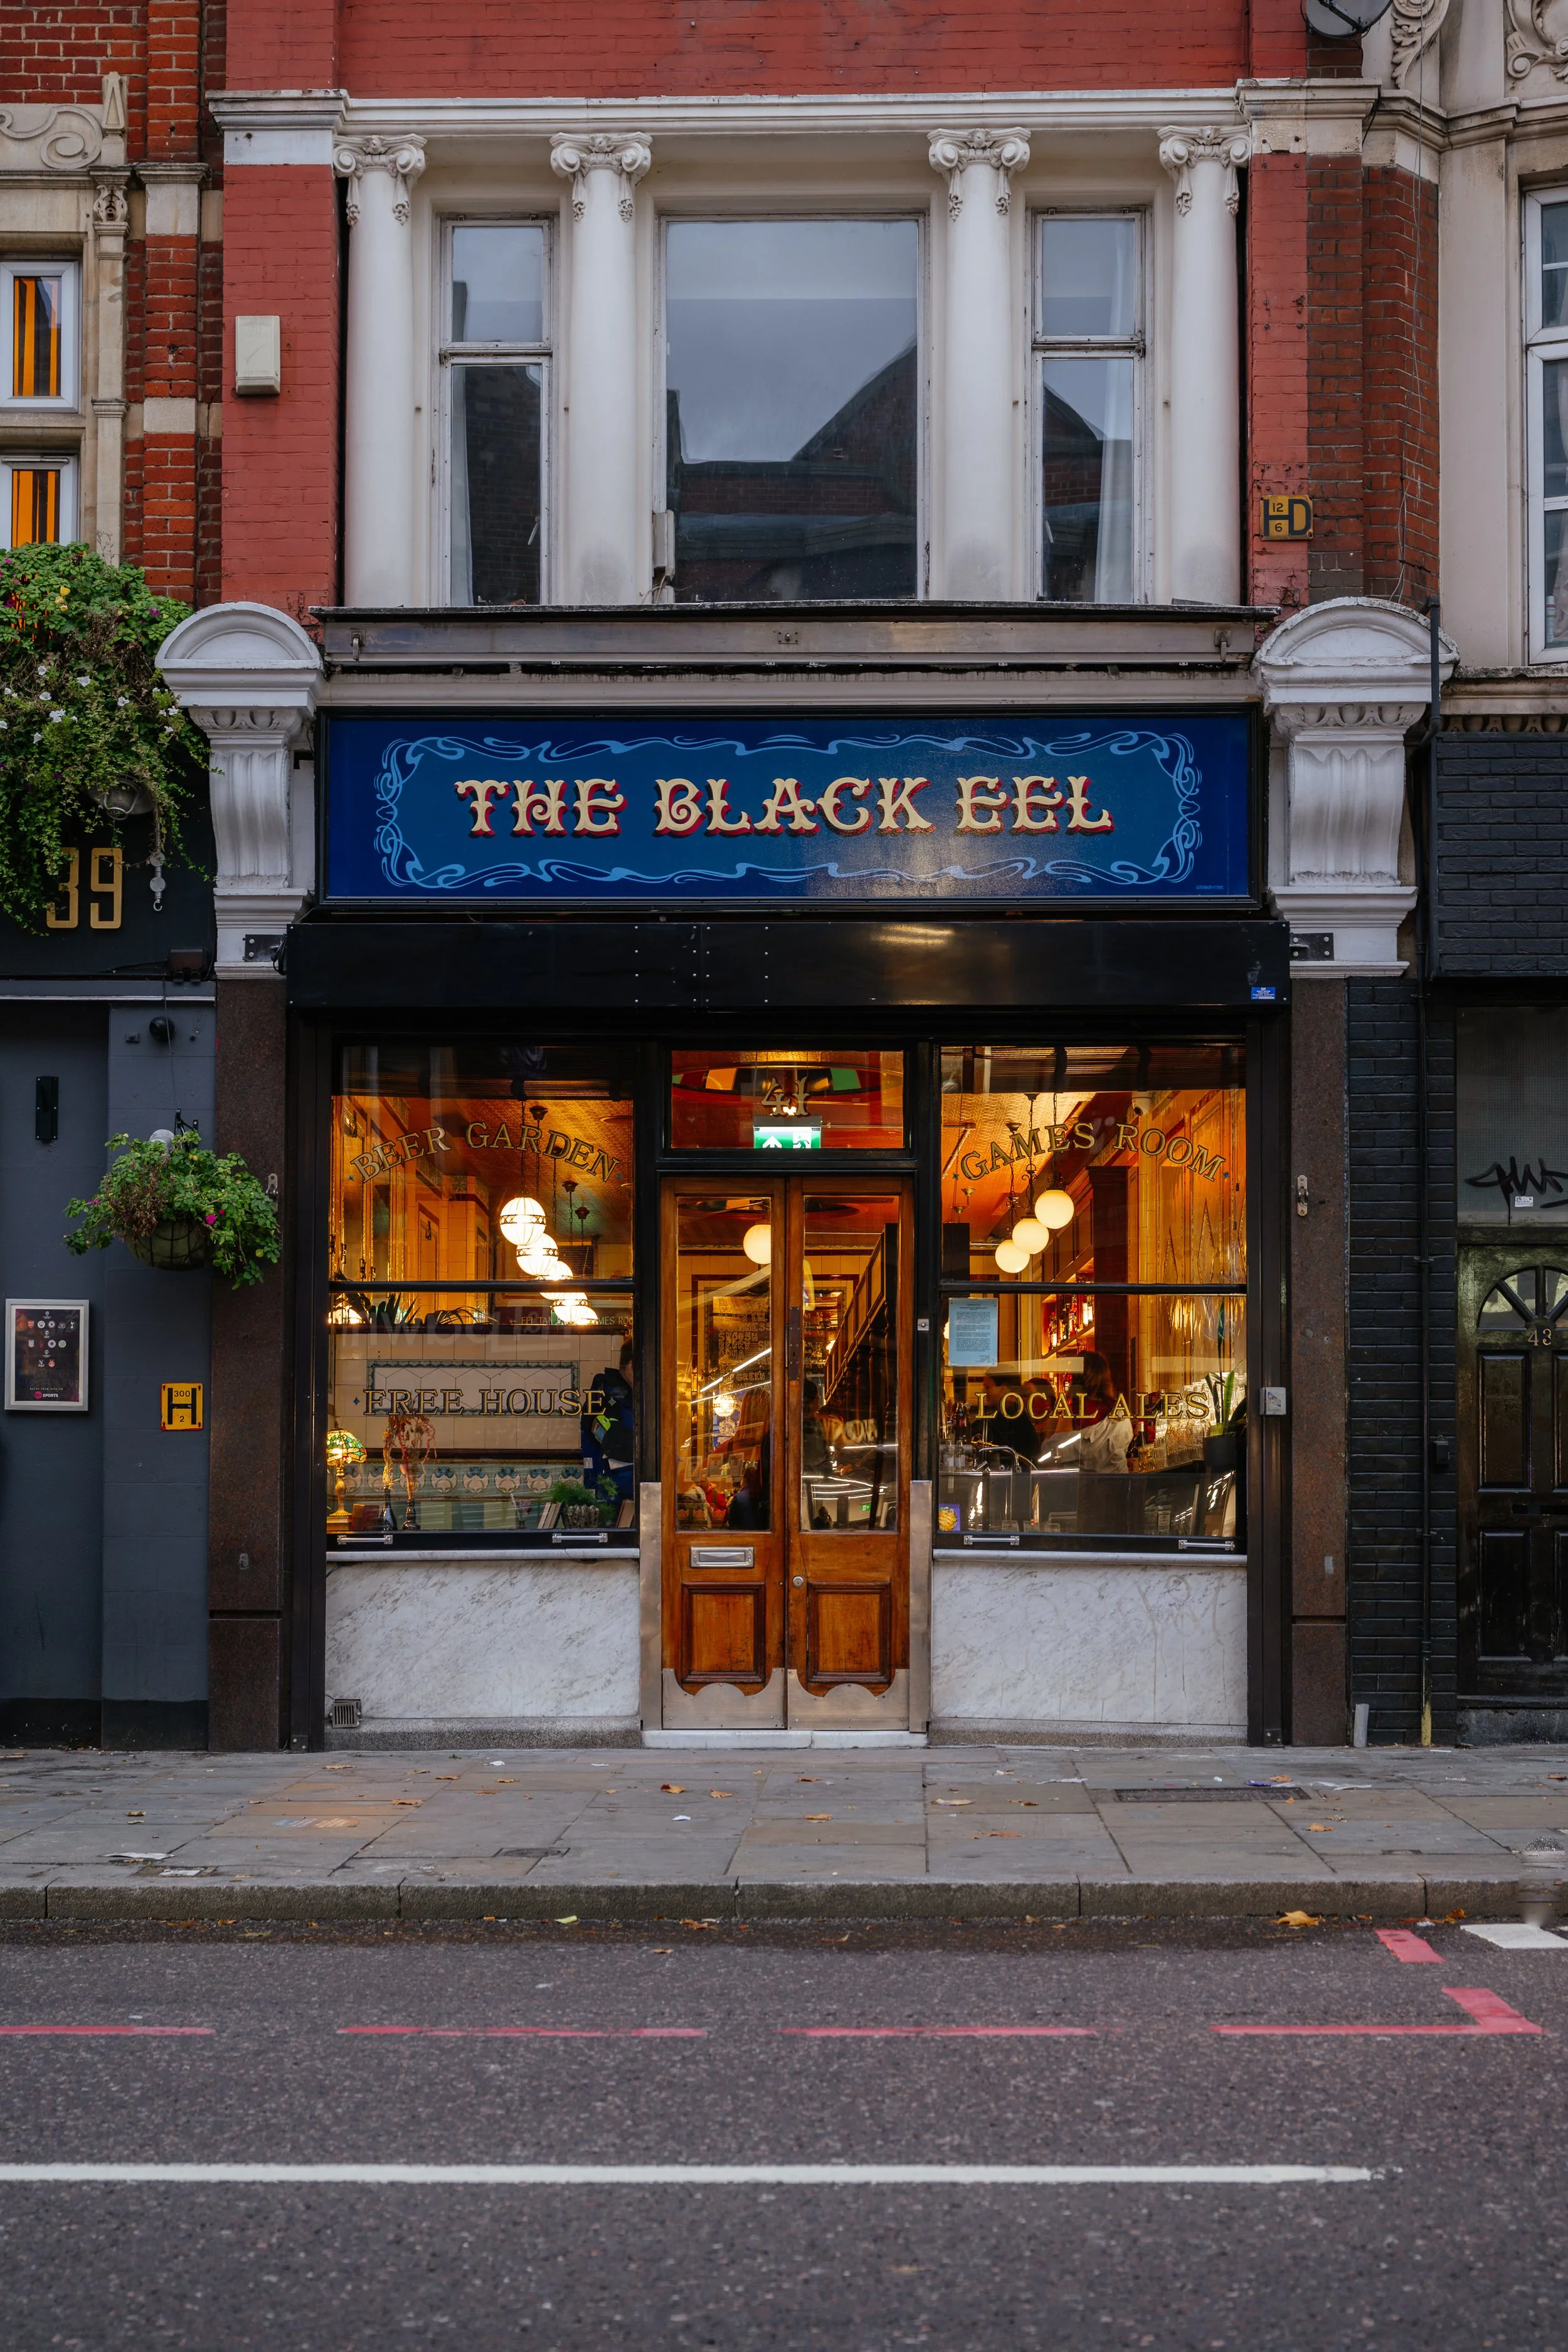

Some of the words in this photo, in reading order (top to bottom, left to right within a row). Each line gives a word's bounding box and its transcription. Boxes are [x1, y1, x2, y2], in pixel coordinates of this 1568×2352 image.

[1272, 502, 1284, 512] 12
[1274, 522, 1283, 532] 6
[455, 778, 627, 838] THE
[654, 777, 935, 838] BLACK
[955, 775, 1115, 836] EEL
[46, 847, 123, 929] 39
[760, 1076, 811, 1117] 41
[349, 1125, 452, 1184] BEER
[465, 1121, 622, 1183] GARDEN
[960, 1122, 1097, 1182] GAMES
[1113, 1123, 1227, 1183] ROOM
[718, 1341, 750, 1350] BERRY
[1527, 1326, 1552, 1347] 43
[736, 1372, 765, 1381] GREEN
[167, 1387, 197, 1425] H
[362, 1388, 465, 1416] FREE
[479, 1388, 607, 1416] HOUSE
[975, 1392, 1099, 1420] LOCAL
[1109, 1392, 1210, 1420] ALES
